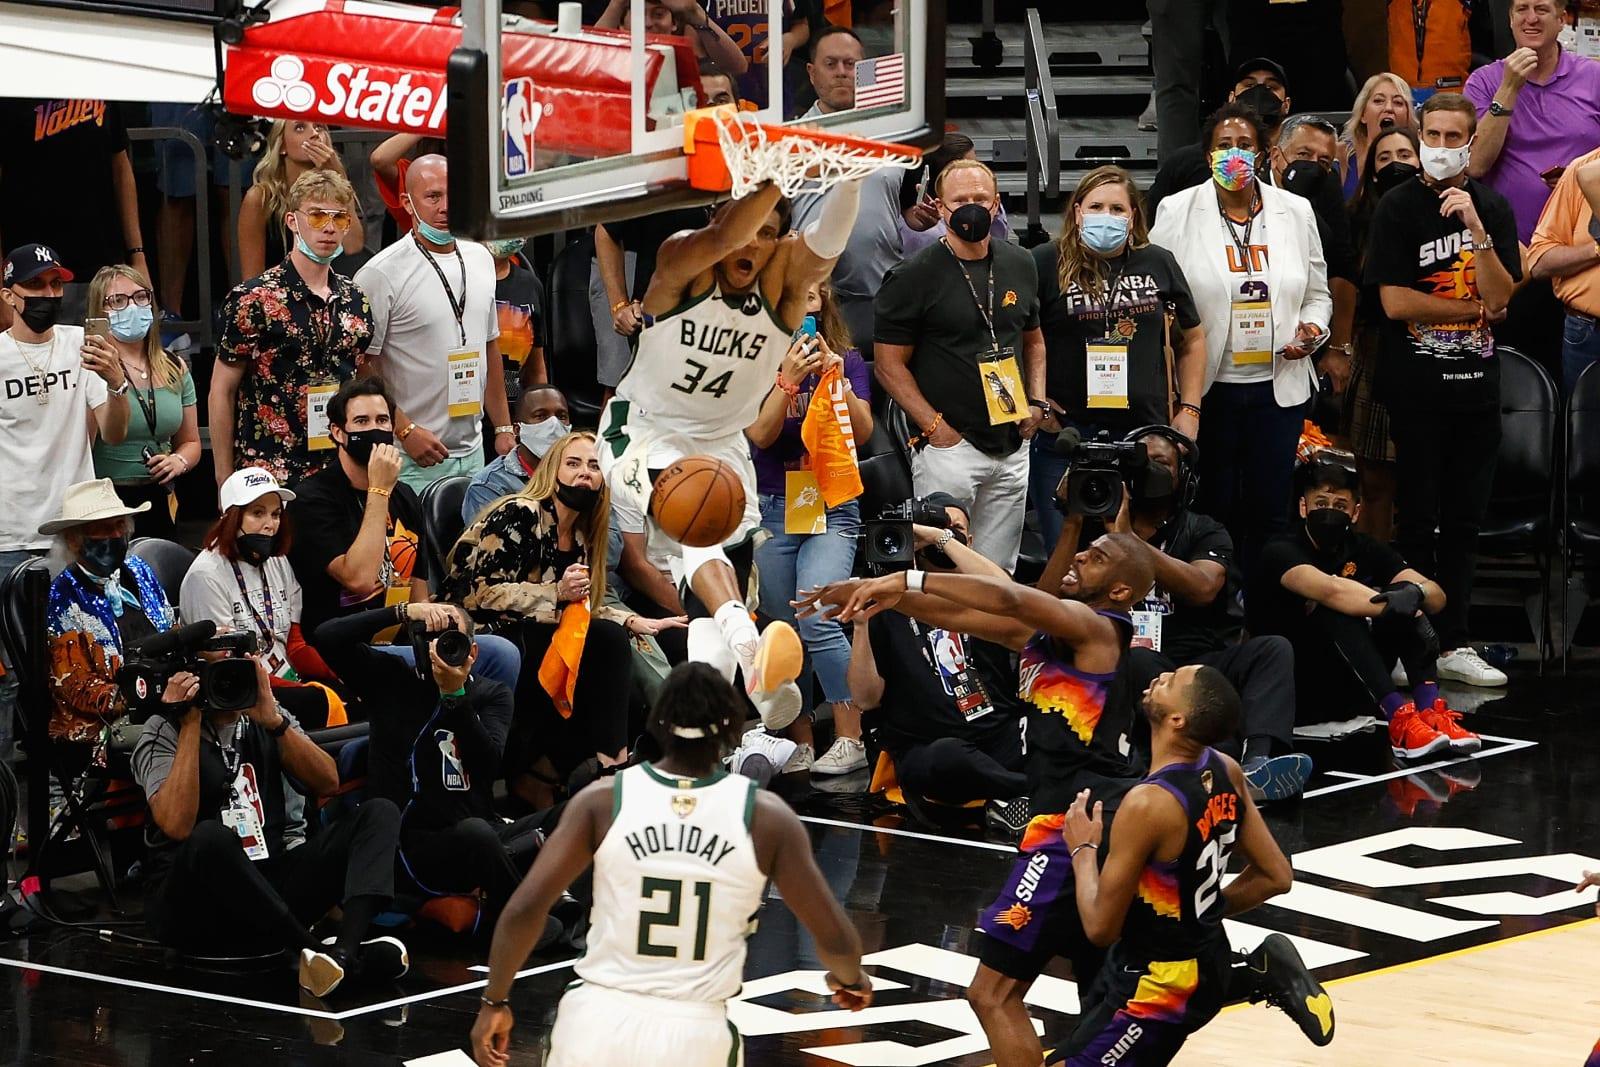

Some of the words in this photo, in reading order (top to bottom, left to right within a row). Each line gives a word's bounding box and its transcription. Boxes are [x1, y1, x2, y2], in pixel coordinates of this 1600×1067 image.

[716, 0, 769, 18] PHOEN
[34, 98, 106, 141] Valley
[499, 188, 543, 209] SPALDING
[1066, 279, 1111, 294] 21
[1117, 275, 1158, 290] NBA
[1129, 304, 1156, 315] SUNS
[681, 319, 767, 361] BUCKS
[5, 370, 77, 399] DEPT.
[671, 358, 734, 399] 34
[447, 774, 462, 786] NBA
[625, 824, 736, 866] HOLIDAY
[1015, 850, 1050, 902] SUNS
[1194, 823, 1238, 920] 25
[637, 876, 711, 961] 21
[1100, 1022, 1144, 1067] SUNS
